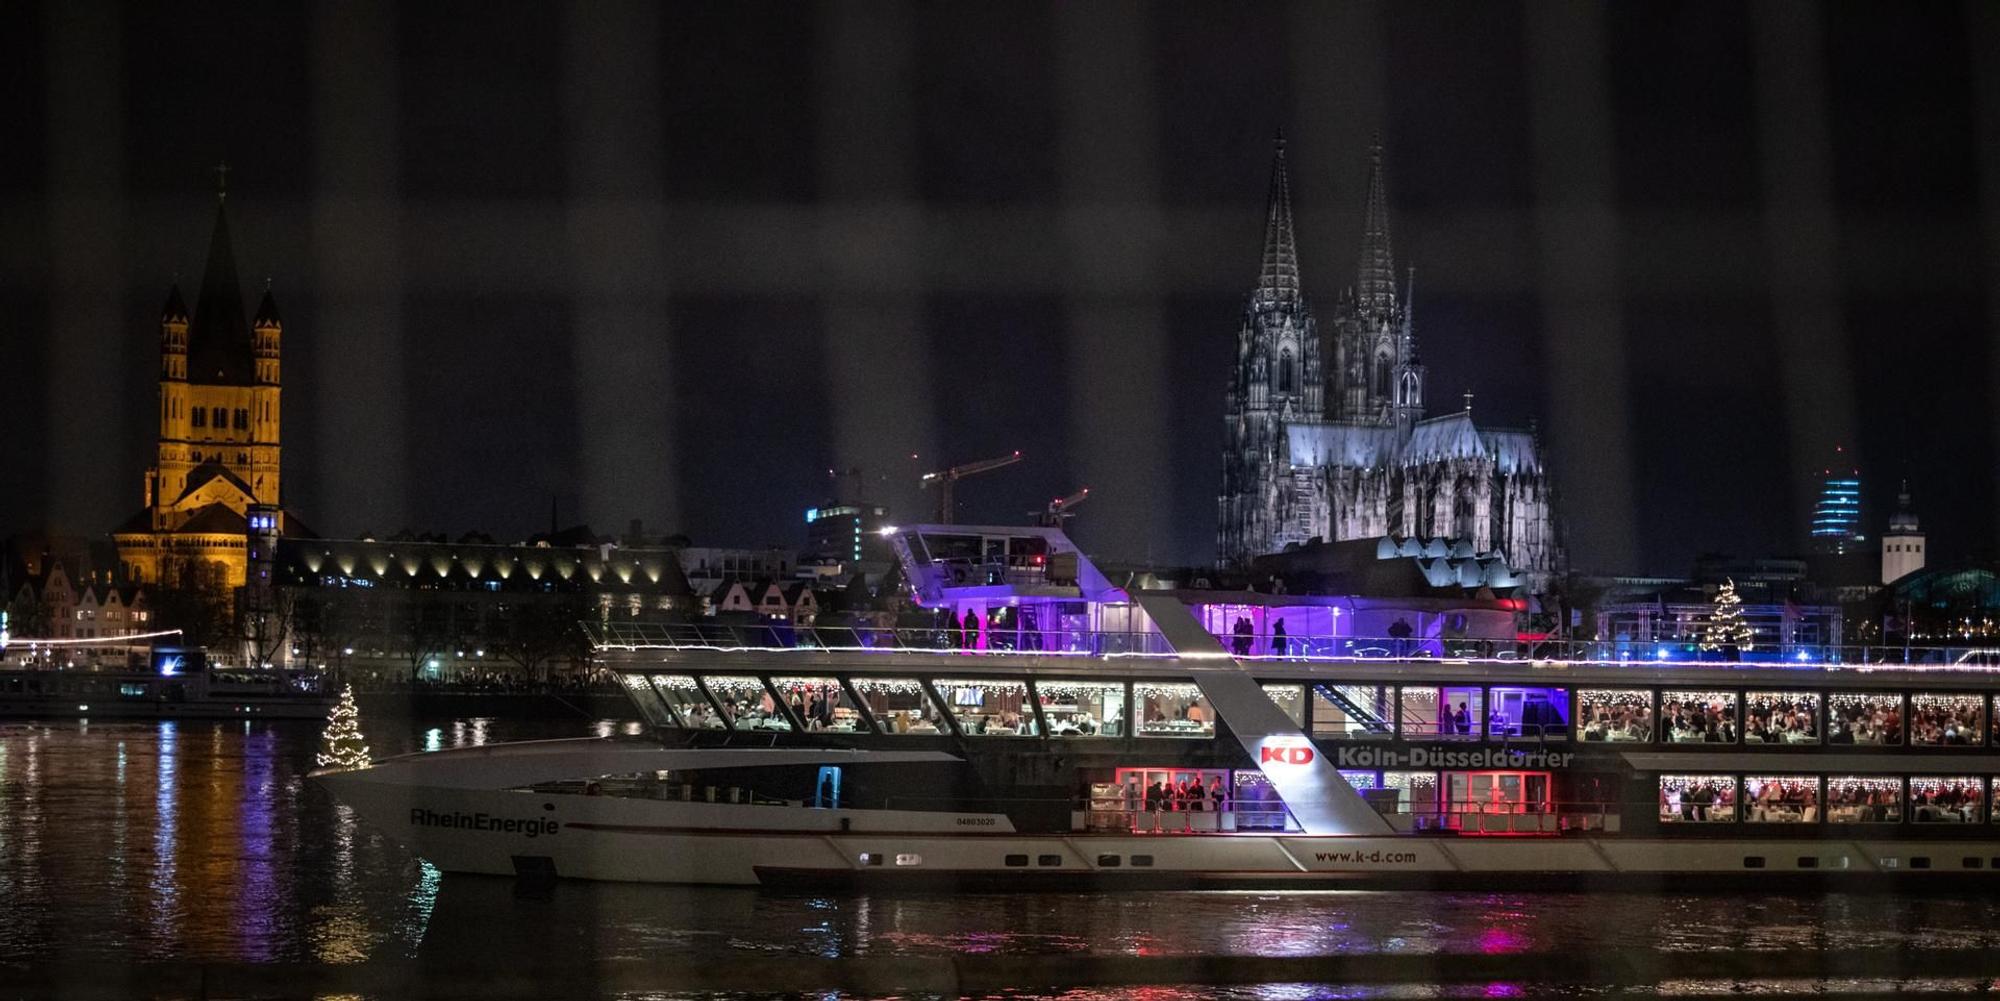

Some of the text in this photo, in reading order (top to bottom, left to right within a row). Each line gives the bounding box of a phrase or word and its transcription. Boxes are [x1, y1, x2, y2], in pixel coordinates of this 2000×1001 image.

[1261, 746, 1314, 765] KD
[1338, 746, 1575, 768] Köln-Düsseldorfer
[411, 808, 559, 838] RheinEnergie
[1315, 850, 1417, 863] www.k-d.com
